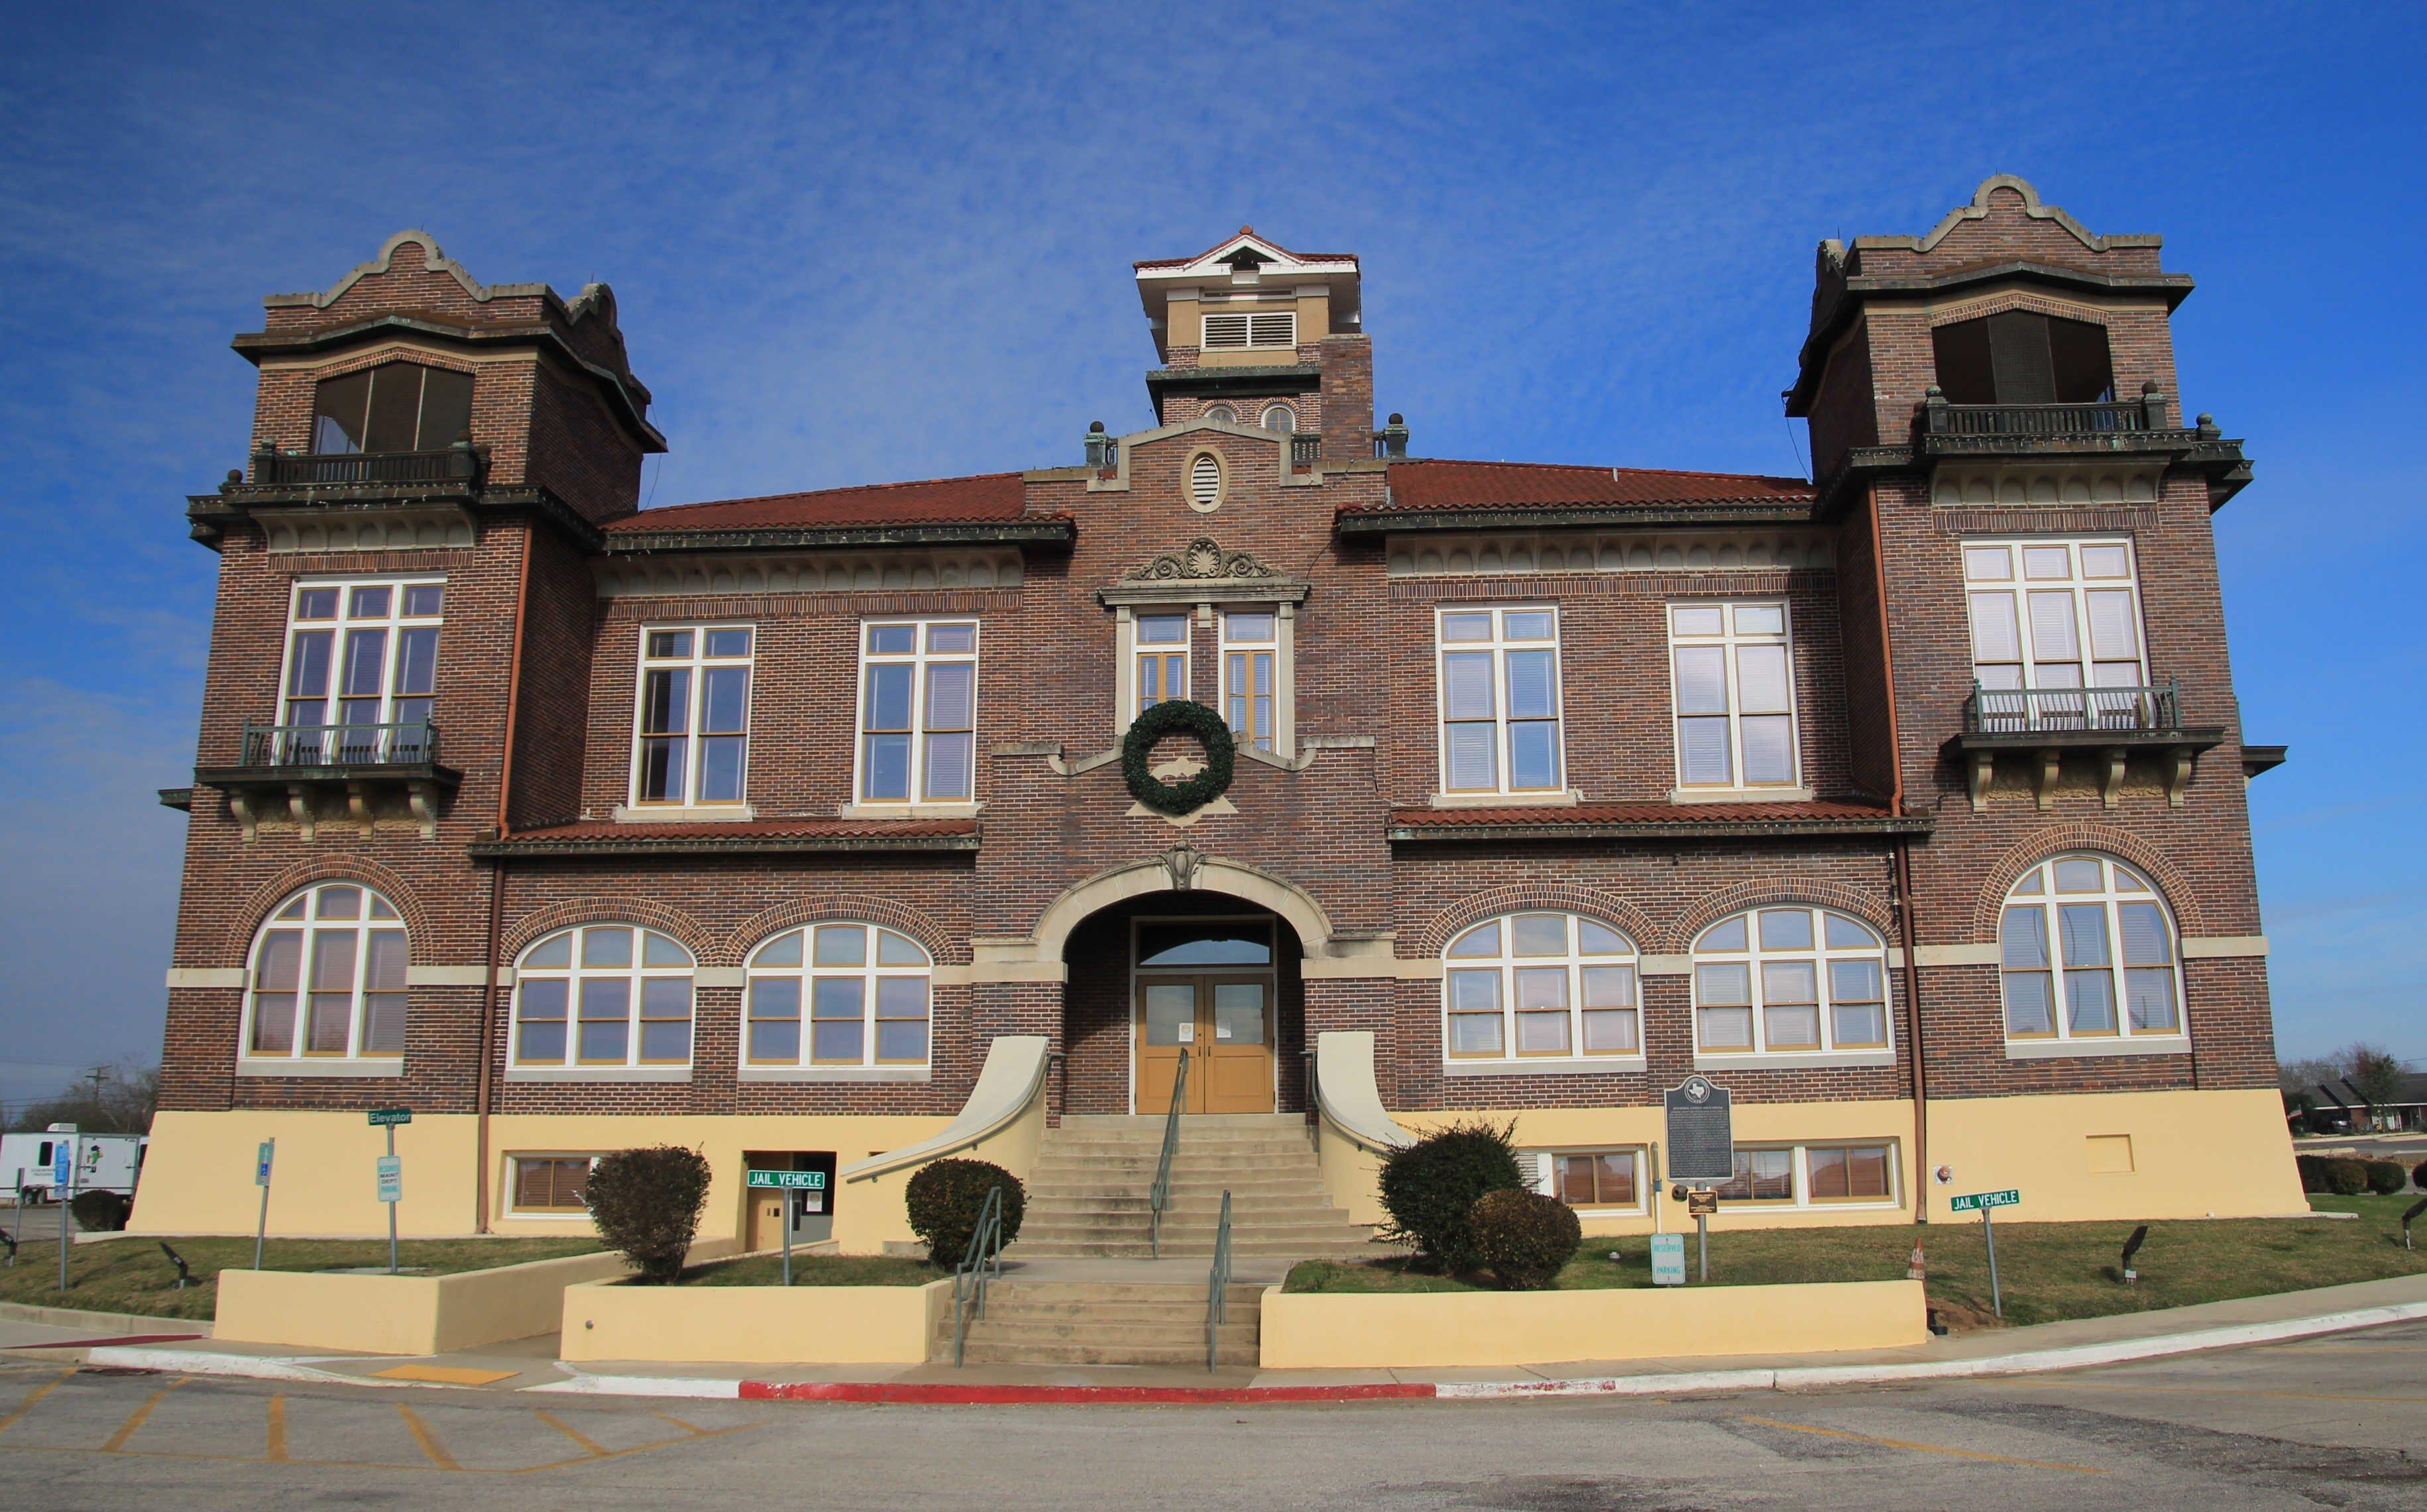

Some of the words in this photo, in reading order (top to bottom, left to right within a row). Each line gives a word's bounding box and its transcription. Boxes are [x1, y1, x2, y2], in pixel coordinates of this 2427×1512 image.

[369, 1113, 410, 1123] Elevator
[752, 1173, 773, 1185] JAIL
[779, 1173, 821, 1186] VEHICLE
[1954, 1197, 1974, 1210] JAIL
[1978, 1191, 2017, 1206] VEHICLE
